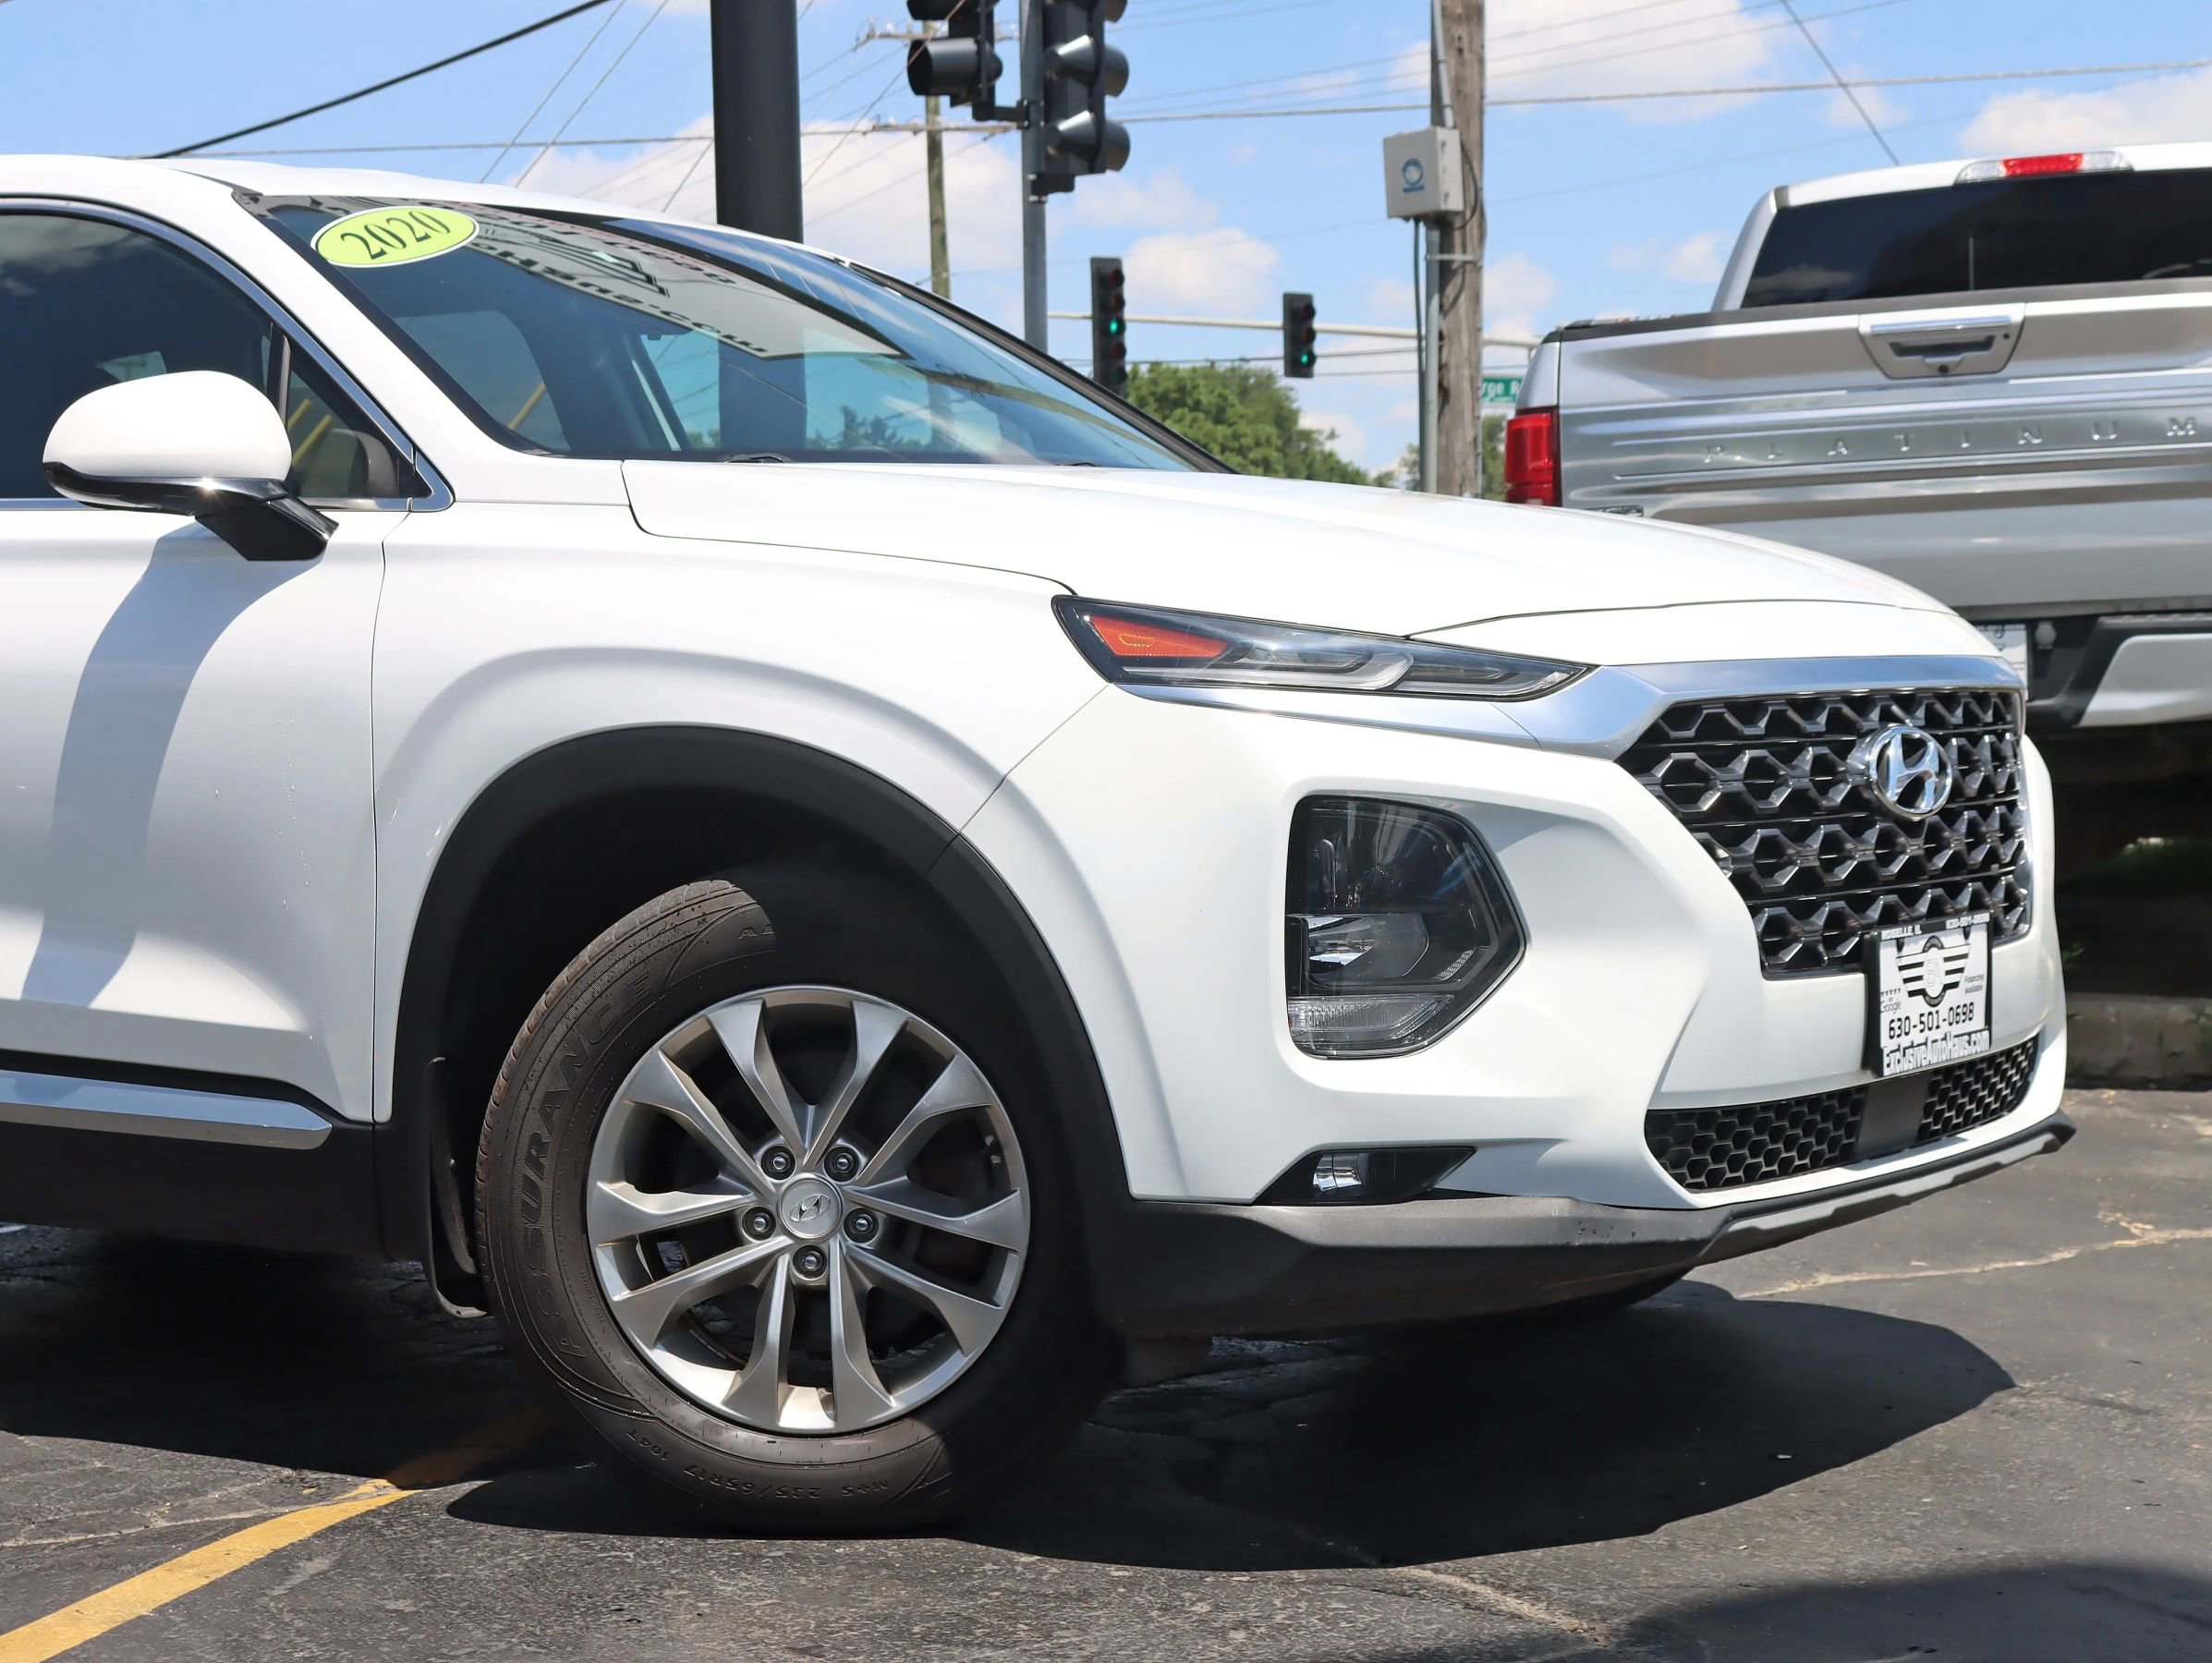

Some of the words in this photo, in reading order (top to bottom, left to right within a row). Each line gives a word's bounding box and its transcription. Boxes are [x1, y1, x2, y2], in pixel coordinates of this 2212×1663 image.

[340, 211, 451, 260] 2020
[1704, 416, 2198, 462] PLATINUM
[1889, 1001, 1975, 1040] 630-501-0698
[683, 1464, 821, 1499] 235/65R17
